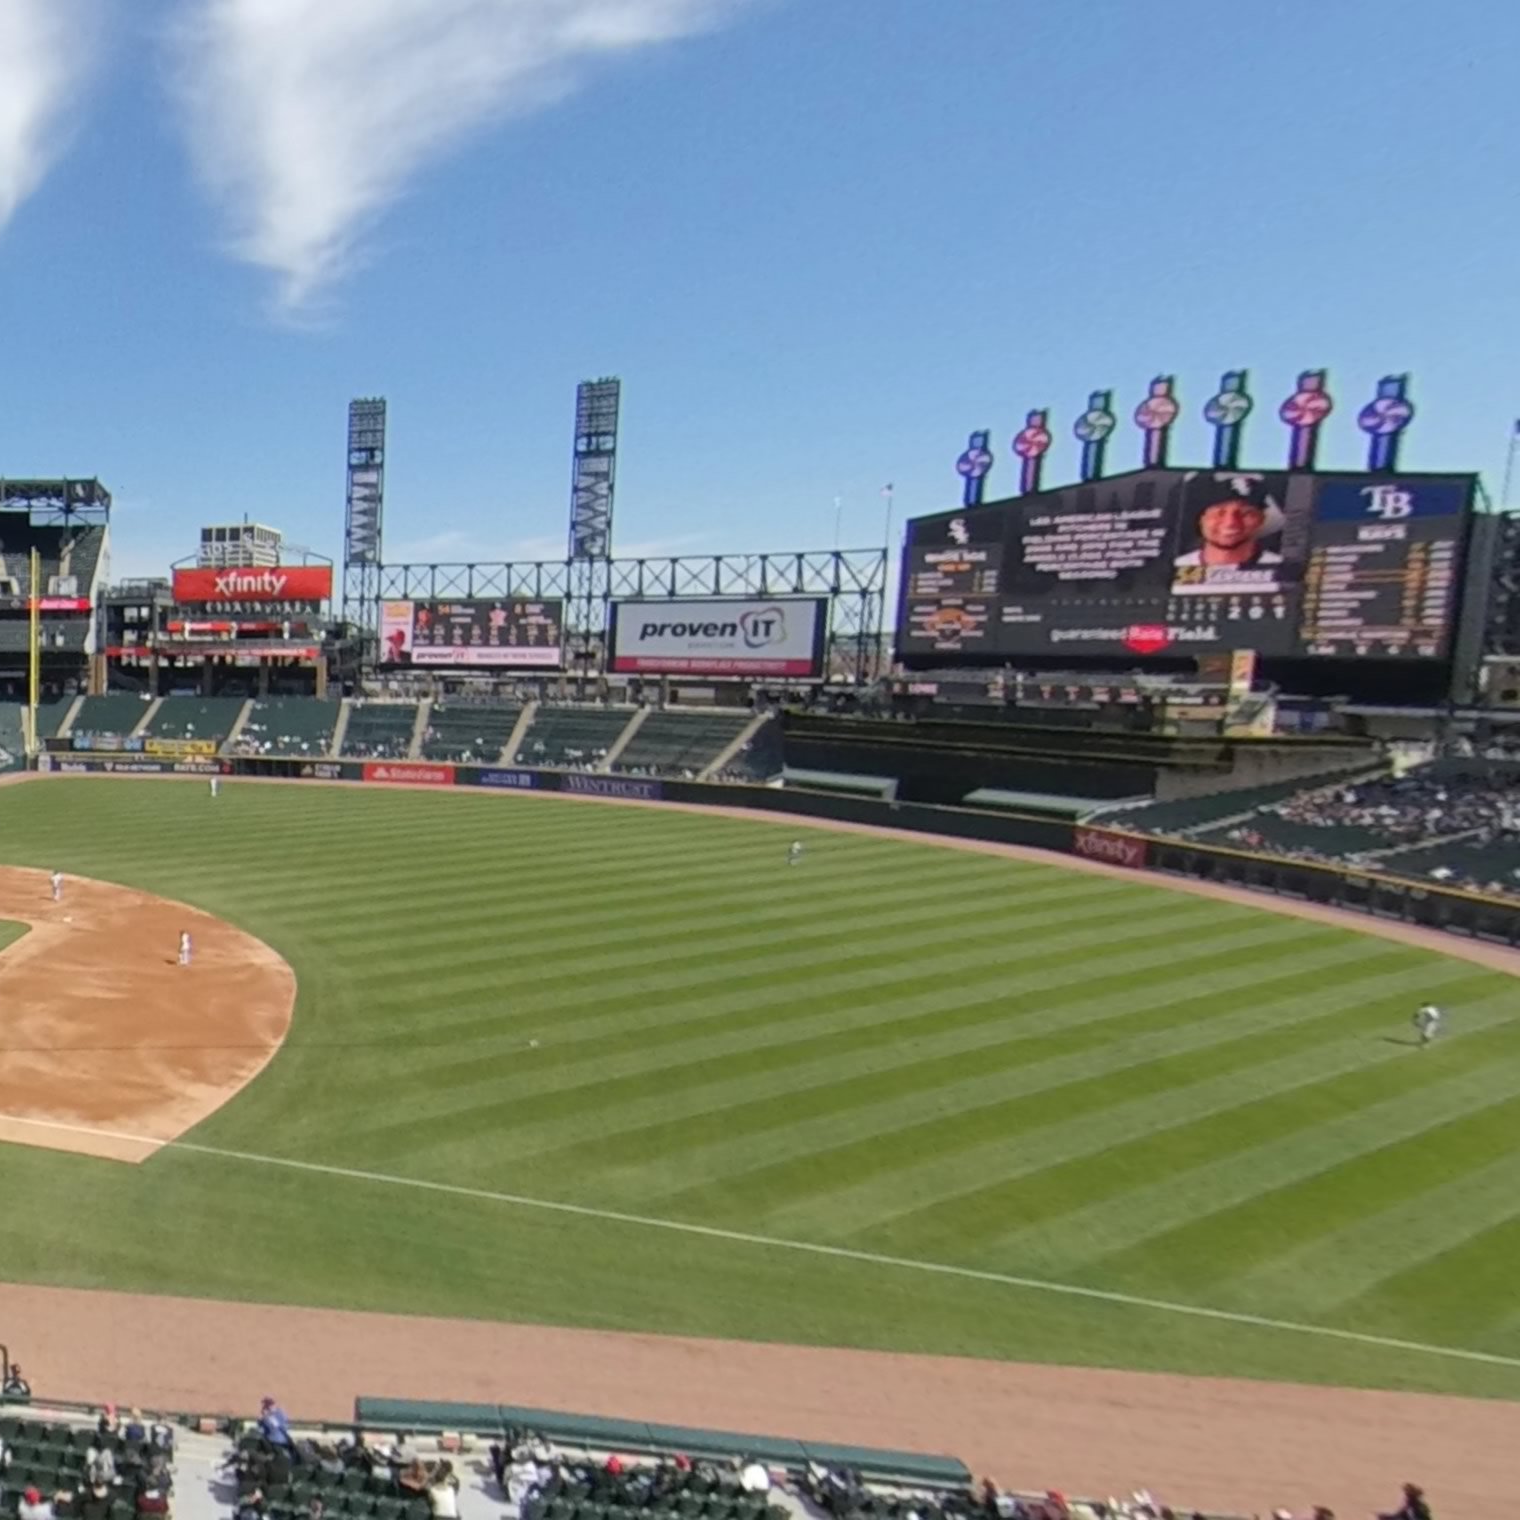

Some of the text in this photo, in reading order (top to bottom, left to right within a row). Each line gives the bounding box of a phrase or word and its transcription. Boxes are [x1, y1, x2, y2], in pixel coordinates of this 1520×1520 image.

[215, 571, 287, 595] xfinity
[639, 618, 778, 642] proven IT
[568, 774, 653, 799] WINTRUST
[1075, 832, 1137, 864] xfinity
